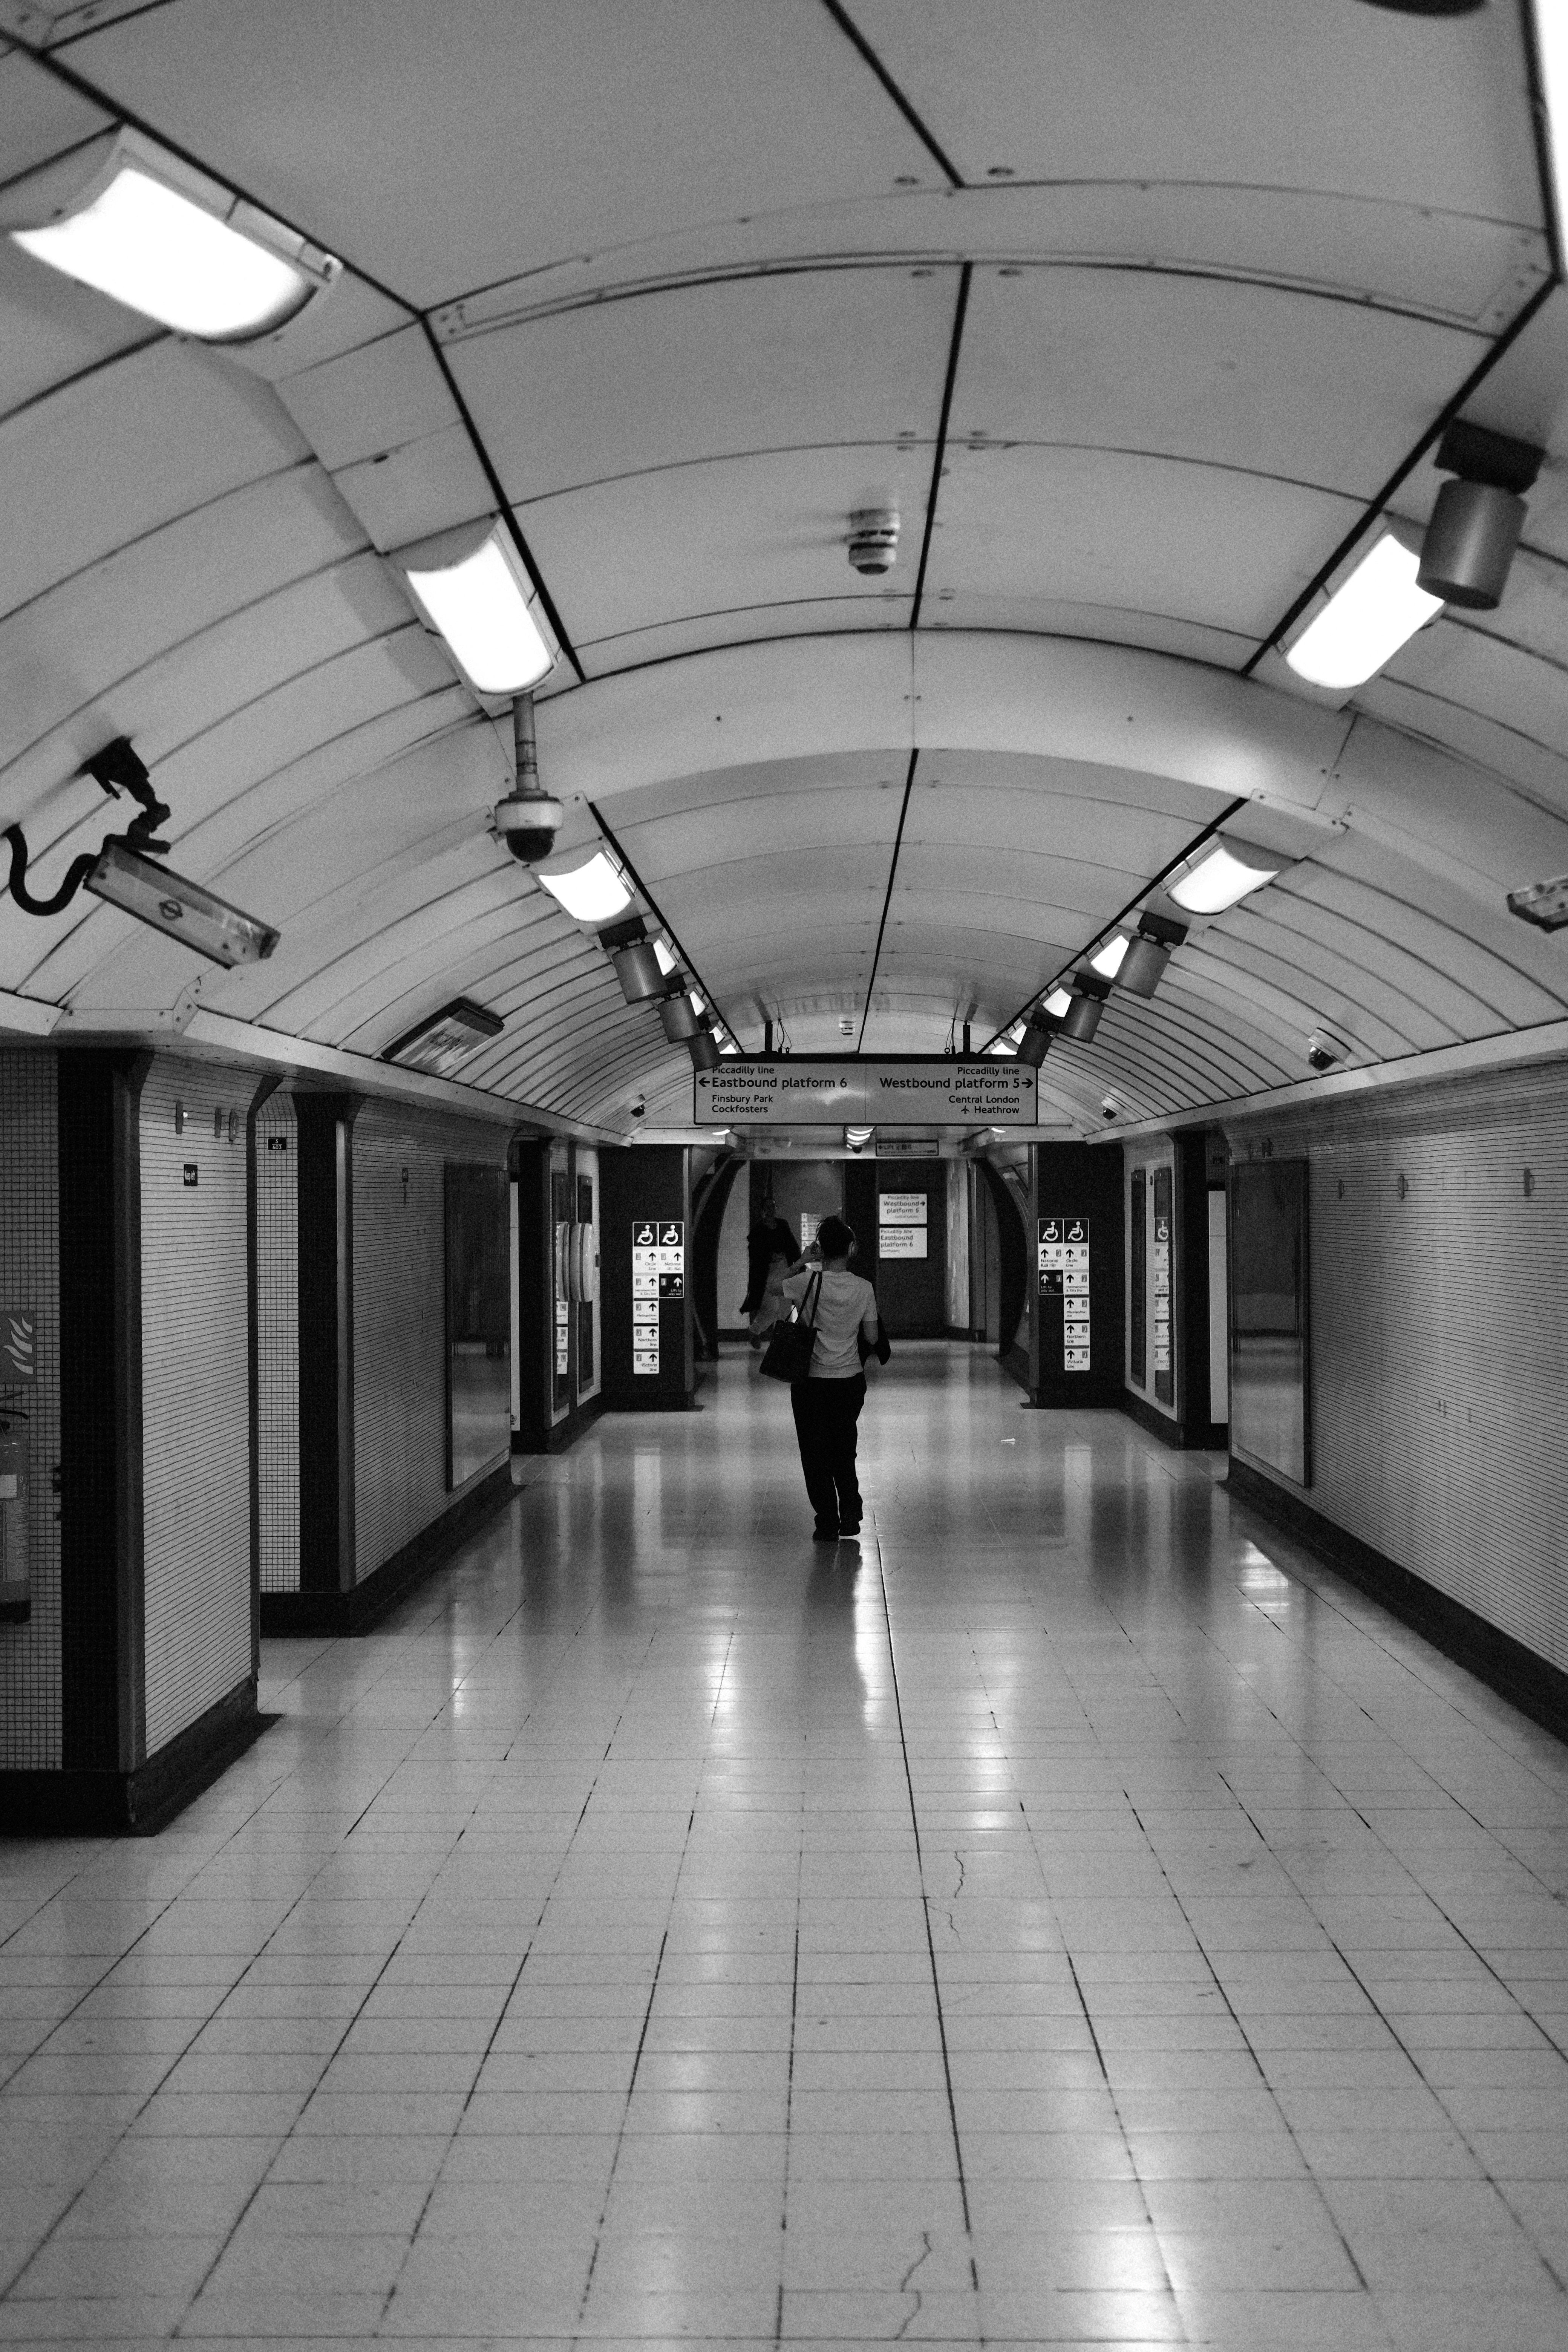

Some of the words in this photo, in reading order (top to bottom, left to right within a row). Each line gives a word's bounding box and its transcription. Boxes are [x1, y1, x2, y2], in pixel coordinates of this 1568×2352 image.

[712, 1066, 755, 1075] Piccadilly
[958, 1067, 999, 1076] Piccadilly
[713, 1078, 776, 1087] Eastbound
[782, 1078, 835, 1089] platform
[841, 1078, 847, 1087] 6
[880, 1078, 950, 1088] Westbound
[956, 1078, 1008, 1089] platform
[1013, 1078, 1019, 1088] 5
[713, 1095, 750, 1104] Finsbury
